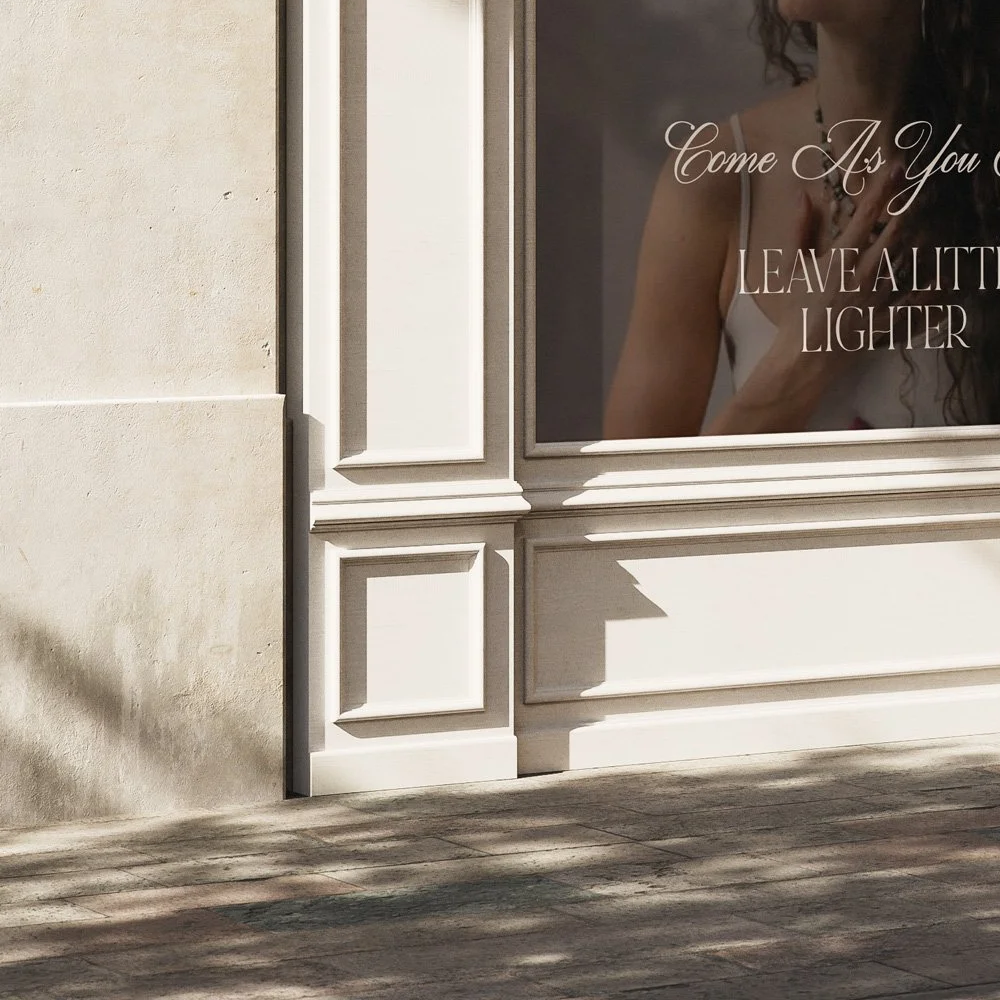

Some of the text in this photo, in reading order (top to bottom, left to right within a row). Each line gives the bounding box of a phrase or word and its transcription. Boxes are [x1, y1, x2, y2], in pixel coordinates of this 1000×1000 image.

[664, 120, 778, 184] Come
[792, 119, 886, 196] As
[886, 121, 982, 216] You
[738, 247, 861, 295] LEAVE
[871, 247, 900, 293] A
[801, 304, 971, 353] LIGHTER
